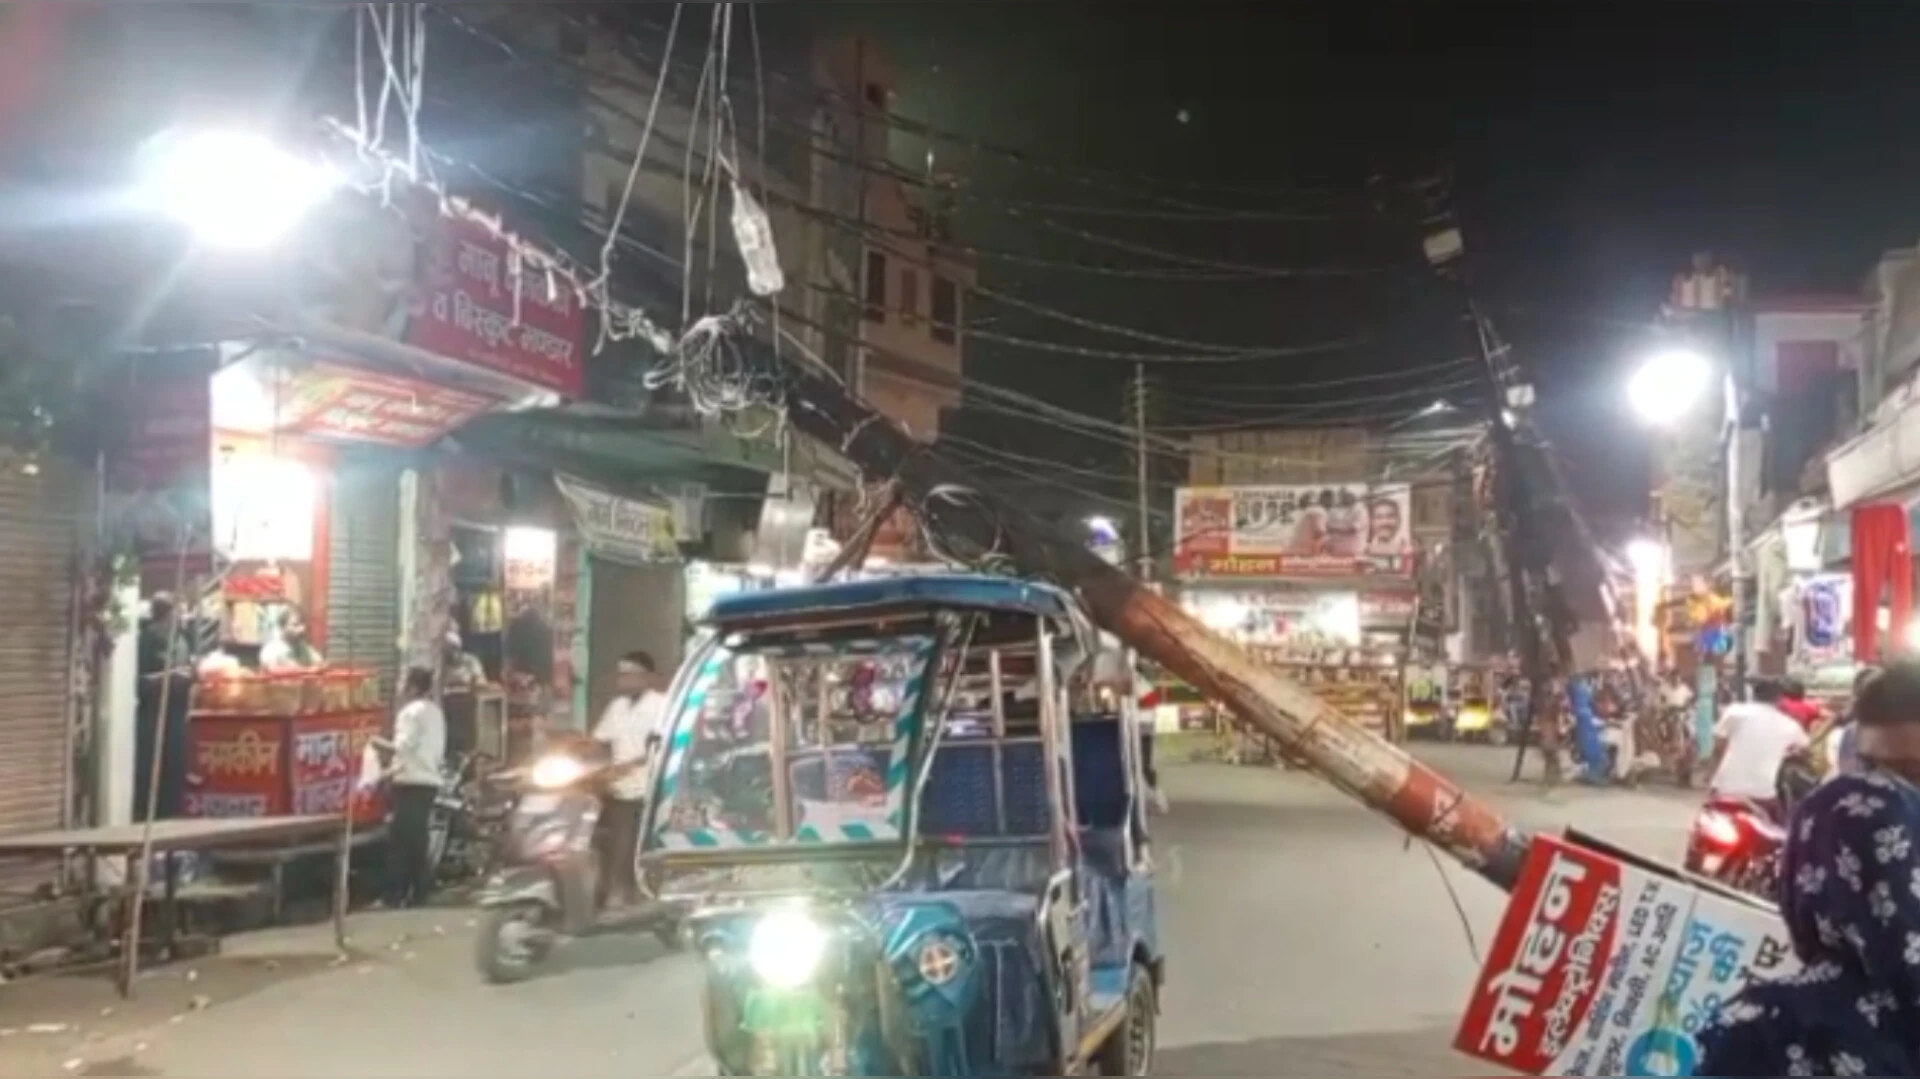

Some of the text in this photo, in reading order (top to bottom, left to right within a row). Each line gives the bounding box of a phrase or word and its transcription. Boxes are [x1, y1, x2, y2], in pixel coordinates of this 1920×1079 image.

[197, 729, 280, 775] नमकीन
[1627, 905, 1649, 938] LED
[1478, 850, 1588, 1056] मोहन
[1641, 943, 1661, 969] AC
[1707, 930, 1746, 984] की
[1753, 932, 1790, 969] पर
